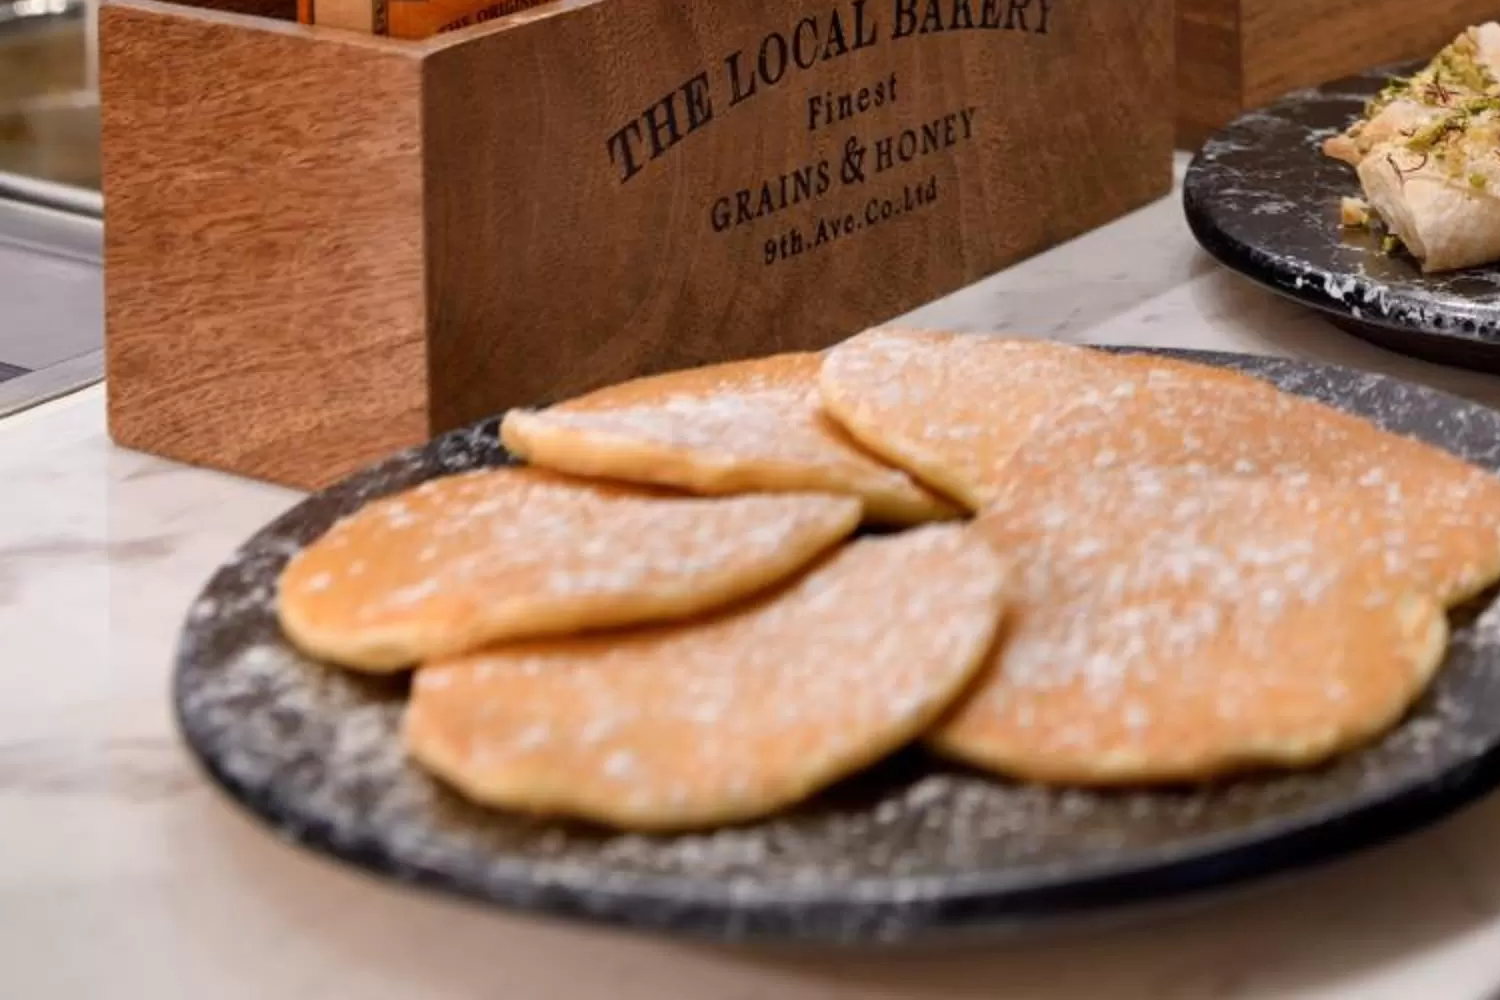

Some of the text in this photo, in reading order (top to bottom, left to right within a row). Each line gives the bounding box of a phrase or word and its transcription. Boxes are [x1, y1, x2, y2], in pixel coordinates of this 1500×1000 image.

[606, 72, 714, 184] THE
[725, 0, 878, 108] LOCAL
[806, 72, 899, 131] Finest
[710, 107, 977, 233] GRAINS & HONEY
